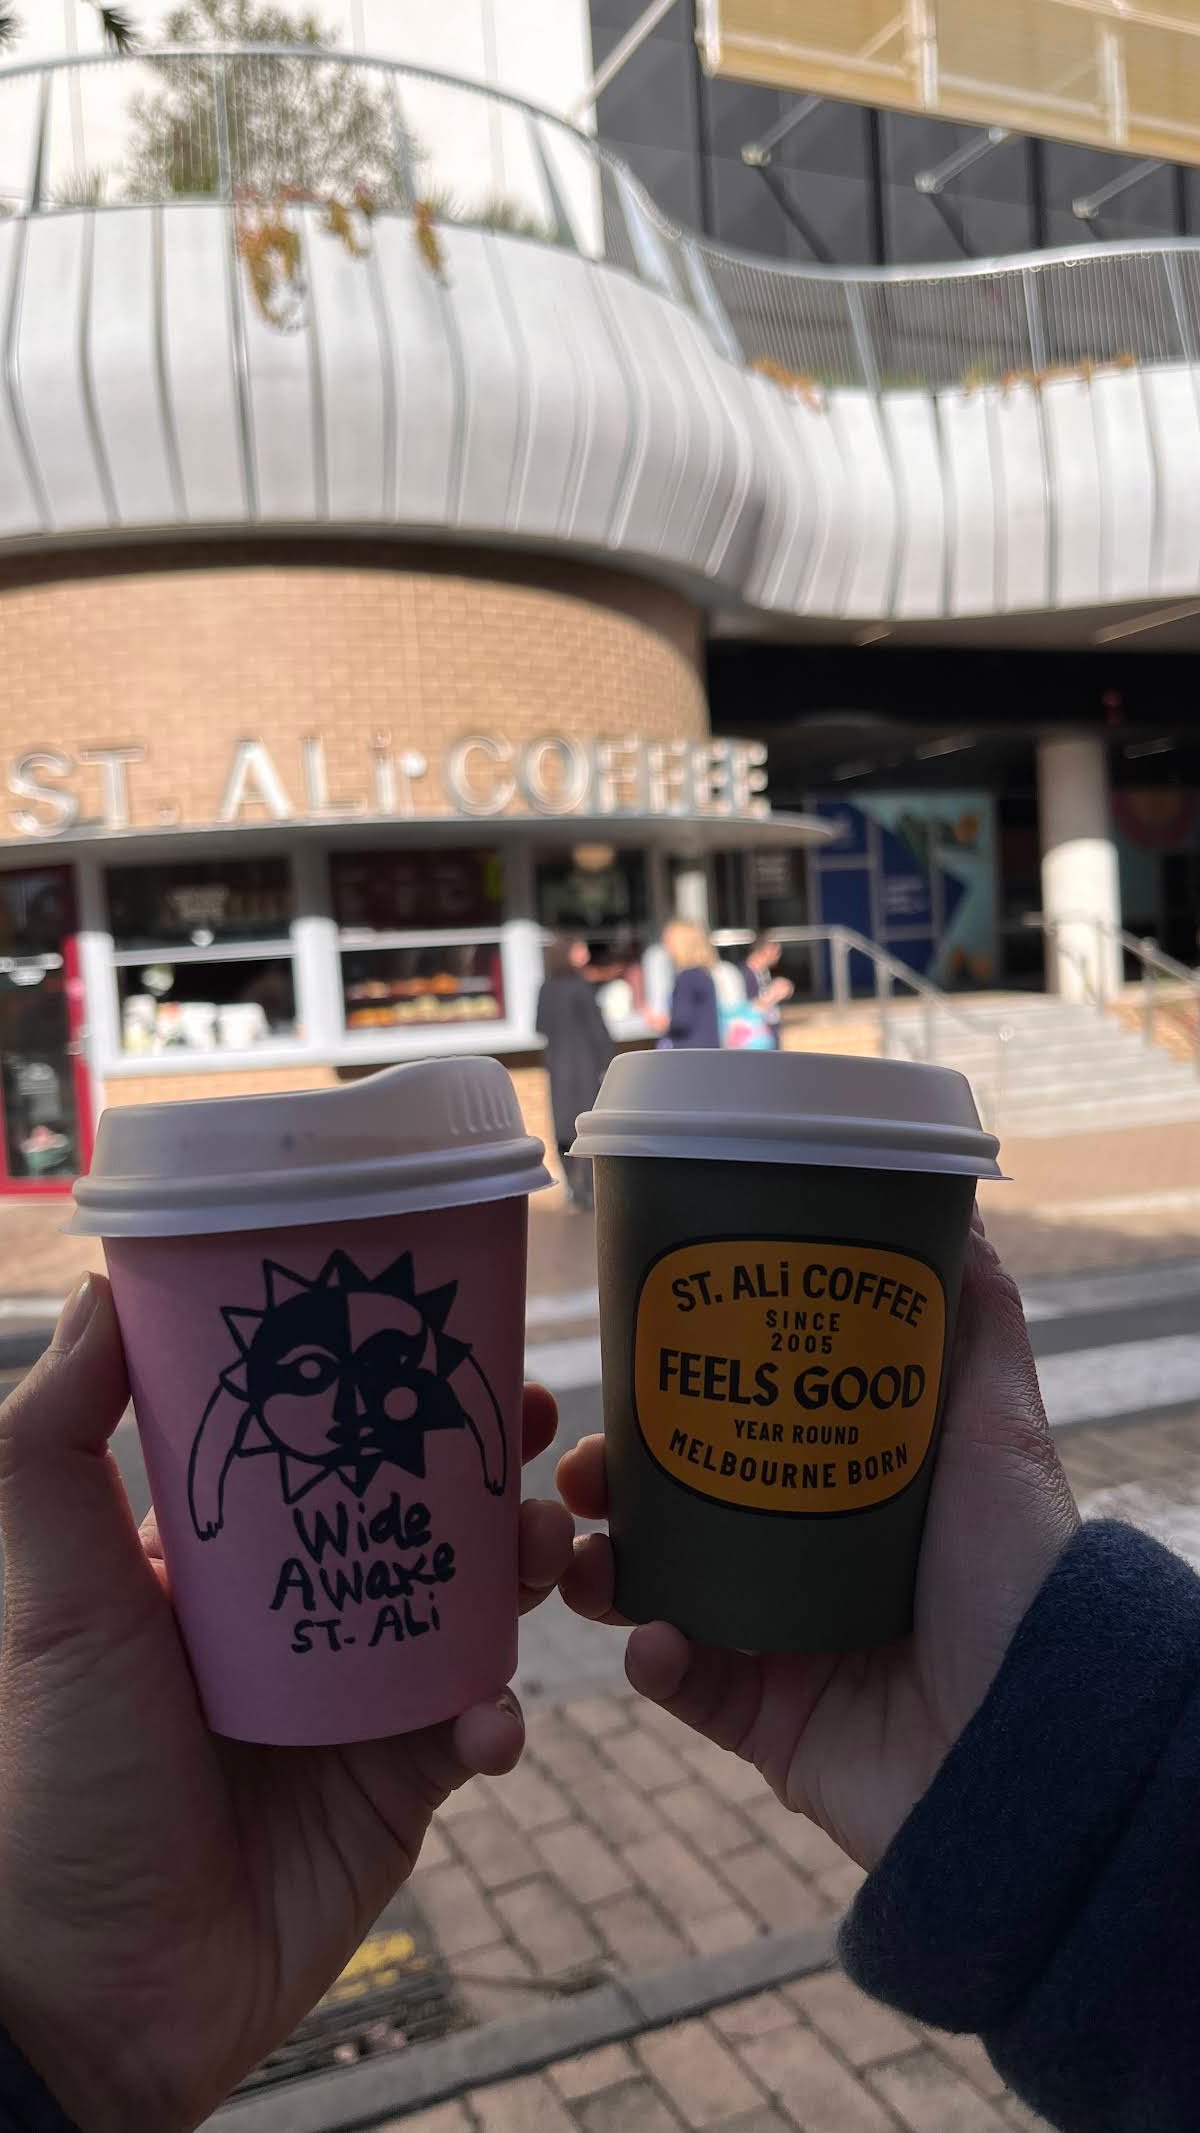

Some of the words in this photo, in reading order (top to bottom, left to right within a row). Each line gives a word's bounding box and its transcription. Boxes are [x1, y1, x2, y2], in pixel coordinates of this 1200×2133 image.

[448, 733, 772, 822] COFFEE
[671, 1271, 723, 1313] ST.
[732, 1261, 789, 1300] ALi
[802, 1264, 927, 1328] COFFEE
[765, 1309, 841, 1333] SINCE
[770, 1332, 833, 1354] 2005
[659, 1347, 780, 1407] FEELS
[793, 1364, 926, 1411] GOOD
[668, 1428, 837, 1490] MELBOURNE
[847, 1443, 908, 1486] BORN
[734, 1419, 784, 1443] YEAR
[792, 1424, 860, 1446] ROUND
[294, 1493, 432, 1563] Wide
